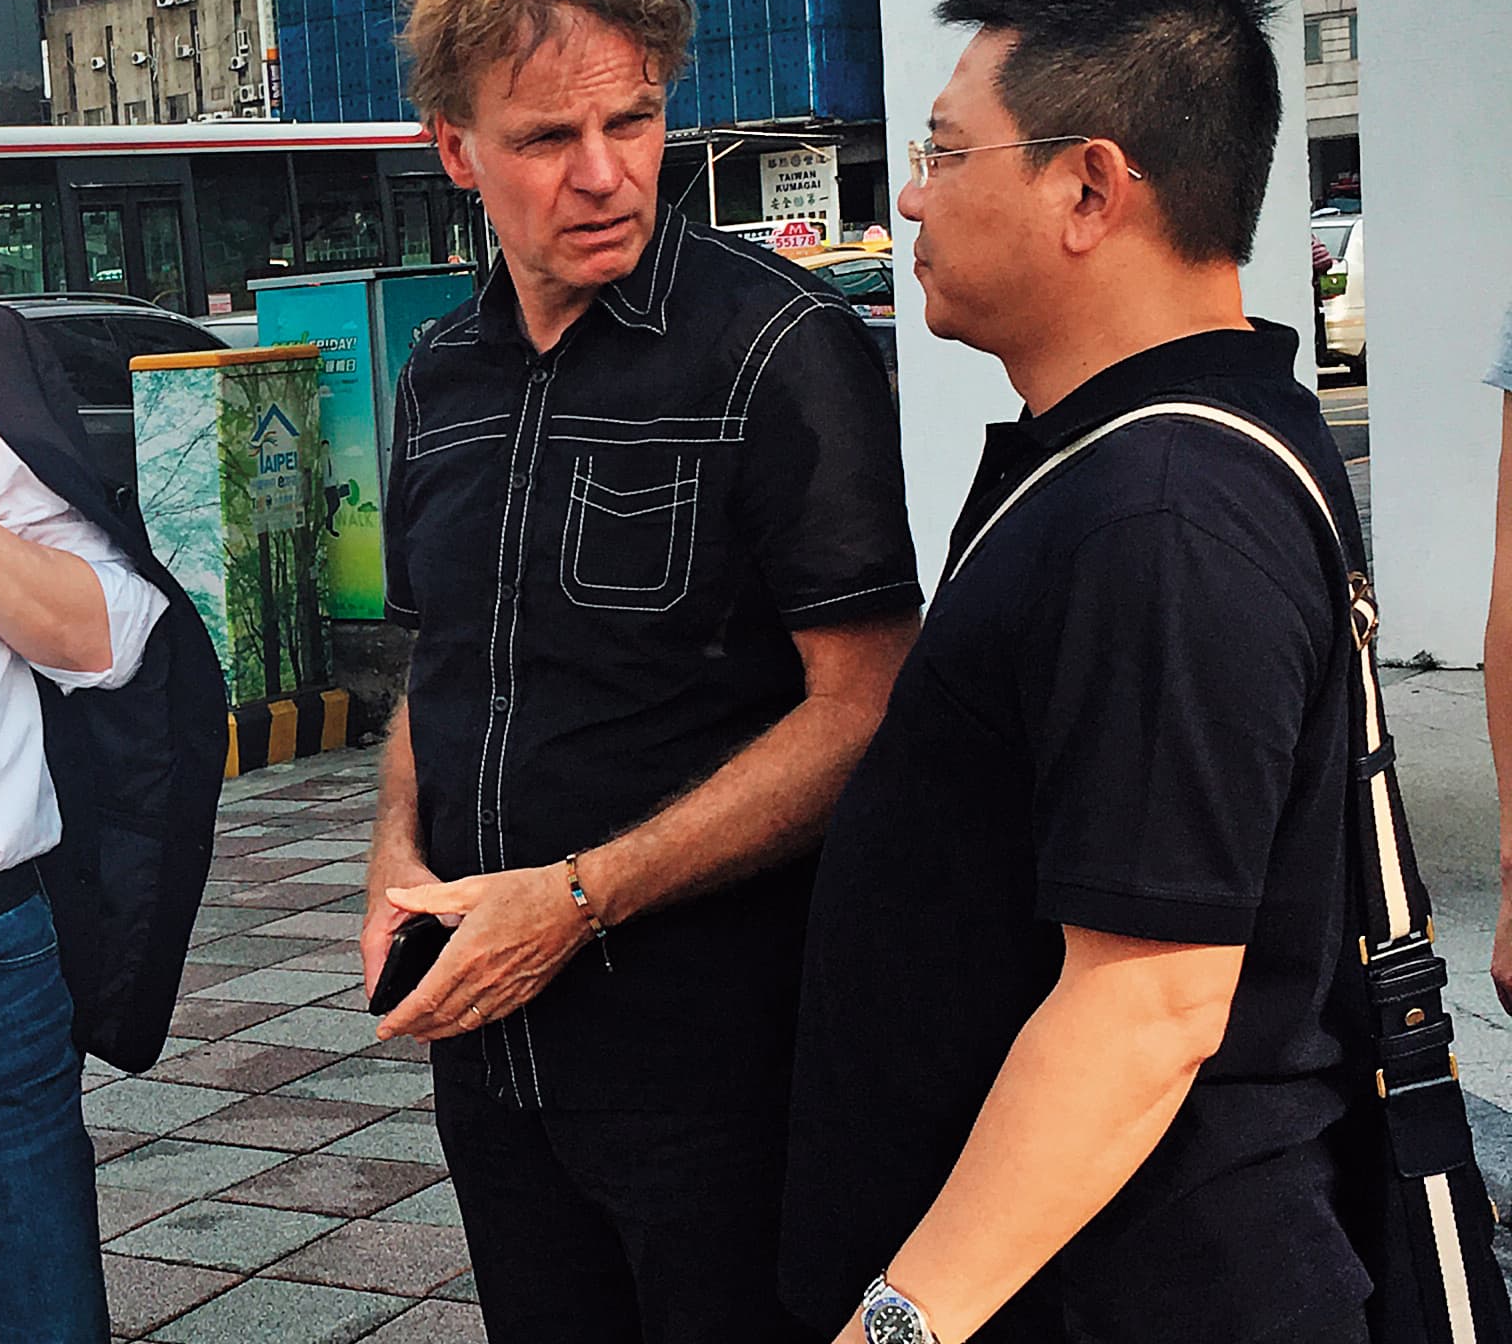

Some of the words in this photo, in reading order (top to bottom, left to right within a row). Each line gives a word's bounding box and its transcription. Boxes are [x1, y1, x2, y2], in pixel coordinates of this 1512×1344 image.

[778, 170, 816, 182] TAIWAN
[776, 180, 821, 193] KUMAGAI
[776, 235, 816, 248] 55178
